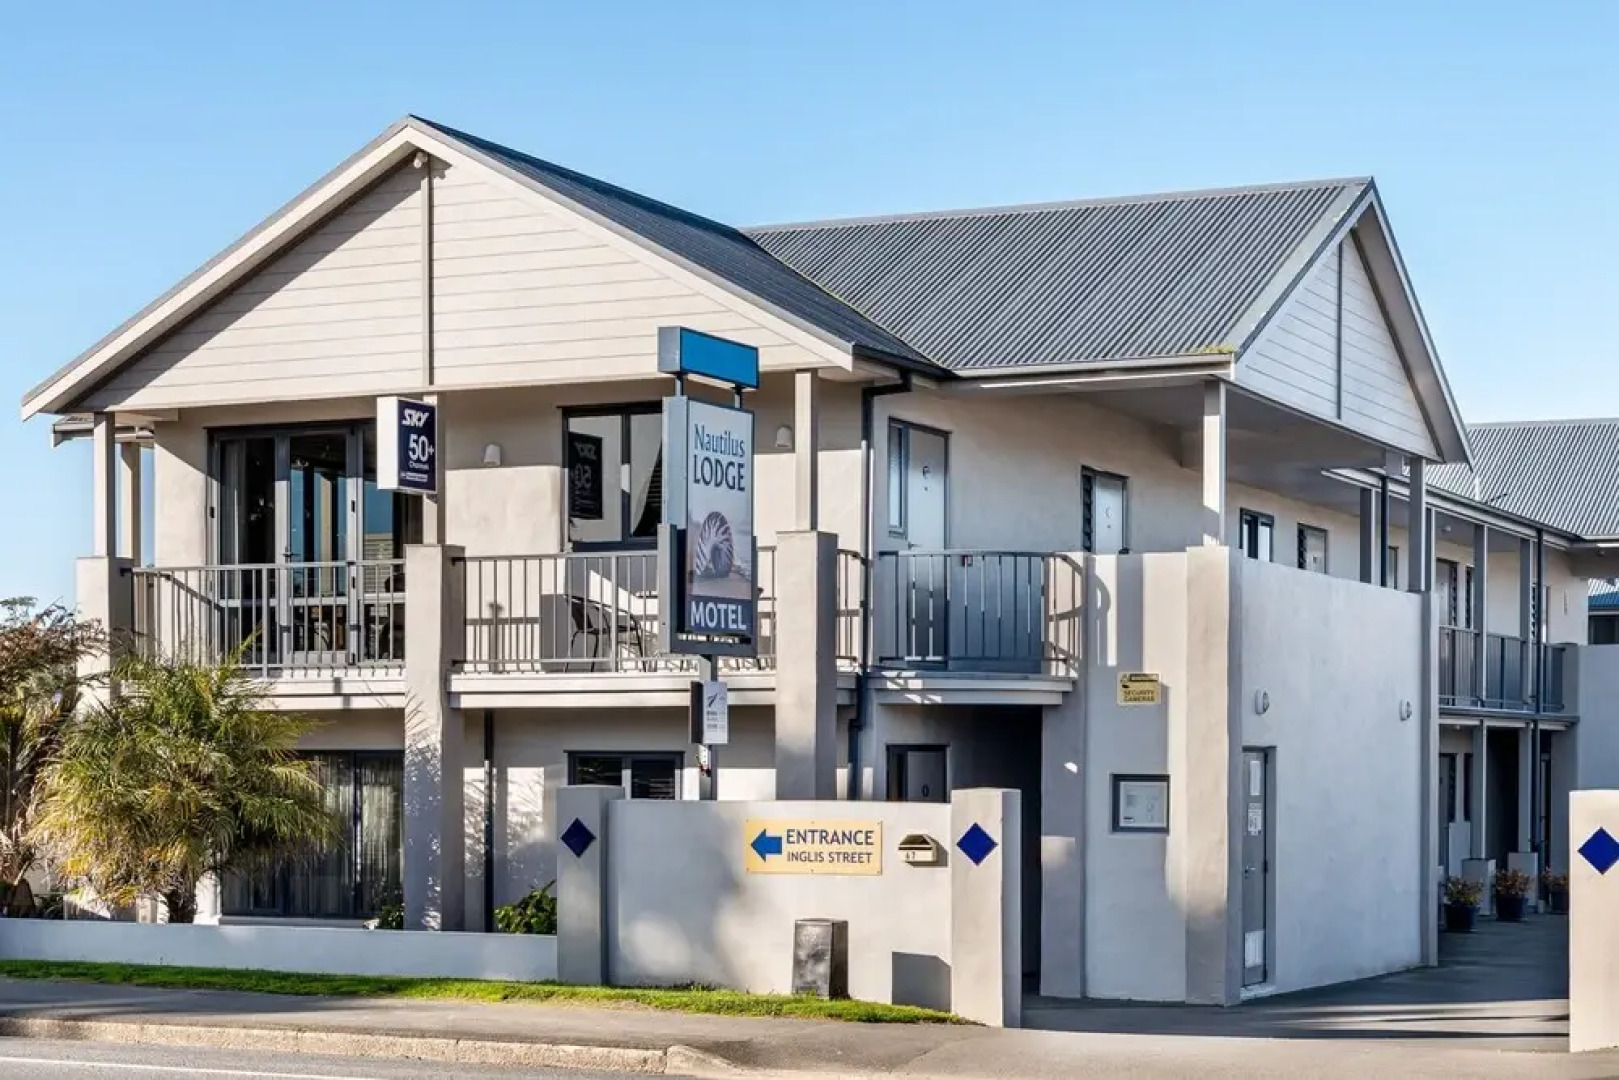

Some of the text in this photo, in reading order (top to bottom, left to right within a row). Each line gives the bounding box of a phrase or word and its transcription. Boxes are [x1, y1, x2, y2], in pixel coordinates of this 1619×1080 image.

[409, 433, 434, 461] 50+
[694, 423, 745, 458] Nautilus
[693, 454, 745, 492] LODGE
[690, 601, 747, 630] MOTEL
[786, 828, 875, 846] ENTRANCE
[787, 851, 873, 864] INGLIS STREET
